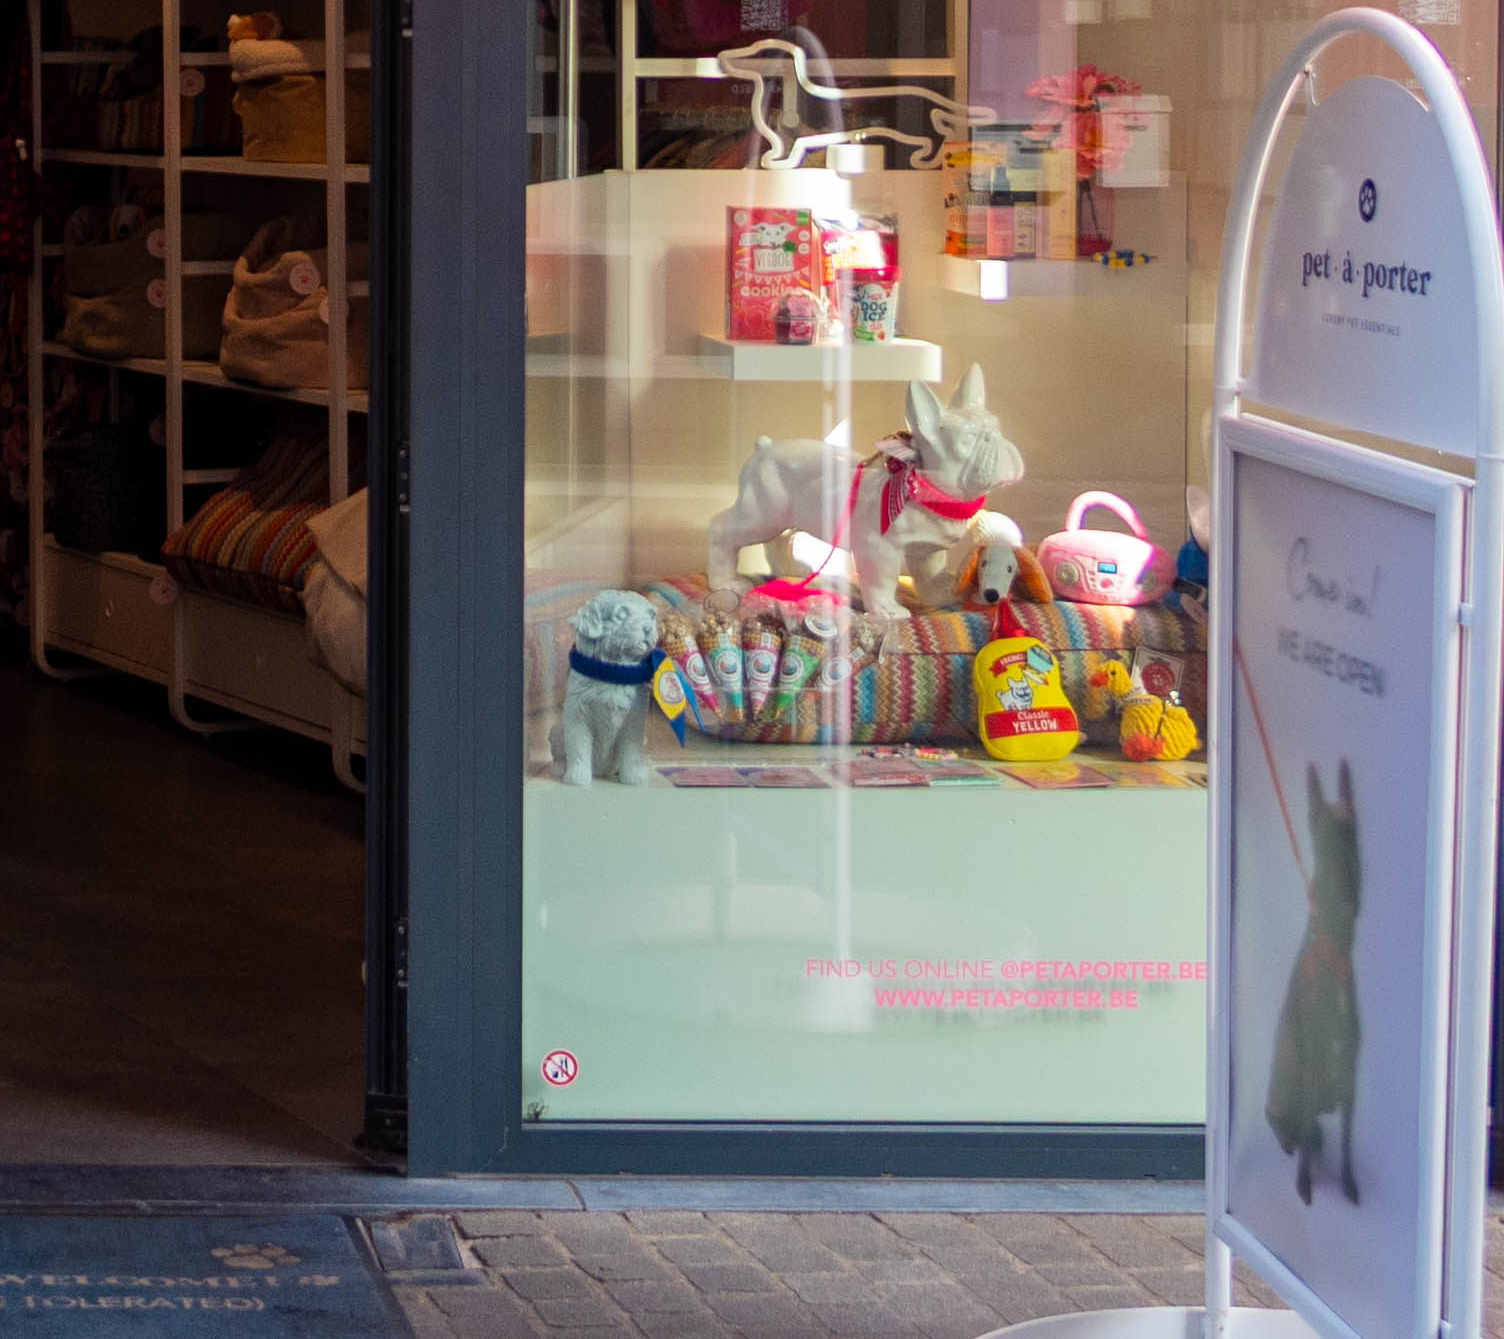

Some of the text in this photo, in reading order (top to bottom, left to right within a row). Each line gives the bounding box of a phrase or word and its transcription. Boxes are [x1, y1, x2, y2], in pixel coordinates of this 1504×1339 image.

[1301, 248, 1332, 287] pet
[1361, 259, 1432, 299] porter
[860, 300, 888, 311] DOG
[863, 311, 886, 322] ICE
[1012, 719, 1058, 733] YELLOW
[806, 960, 1207, 983] FIND US ONLINE @PETAPORTER.BE
[874, 989, 1140, 1011] WWW.PETAPORTER.BE
